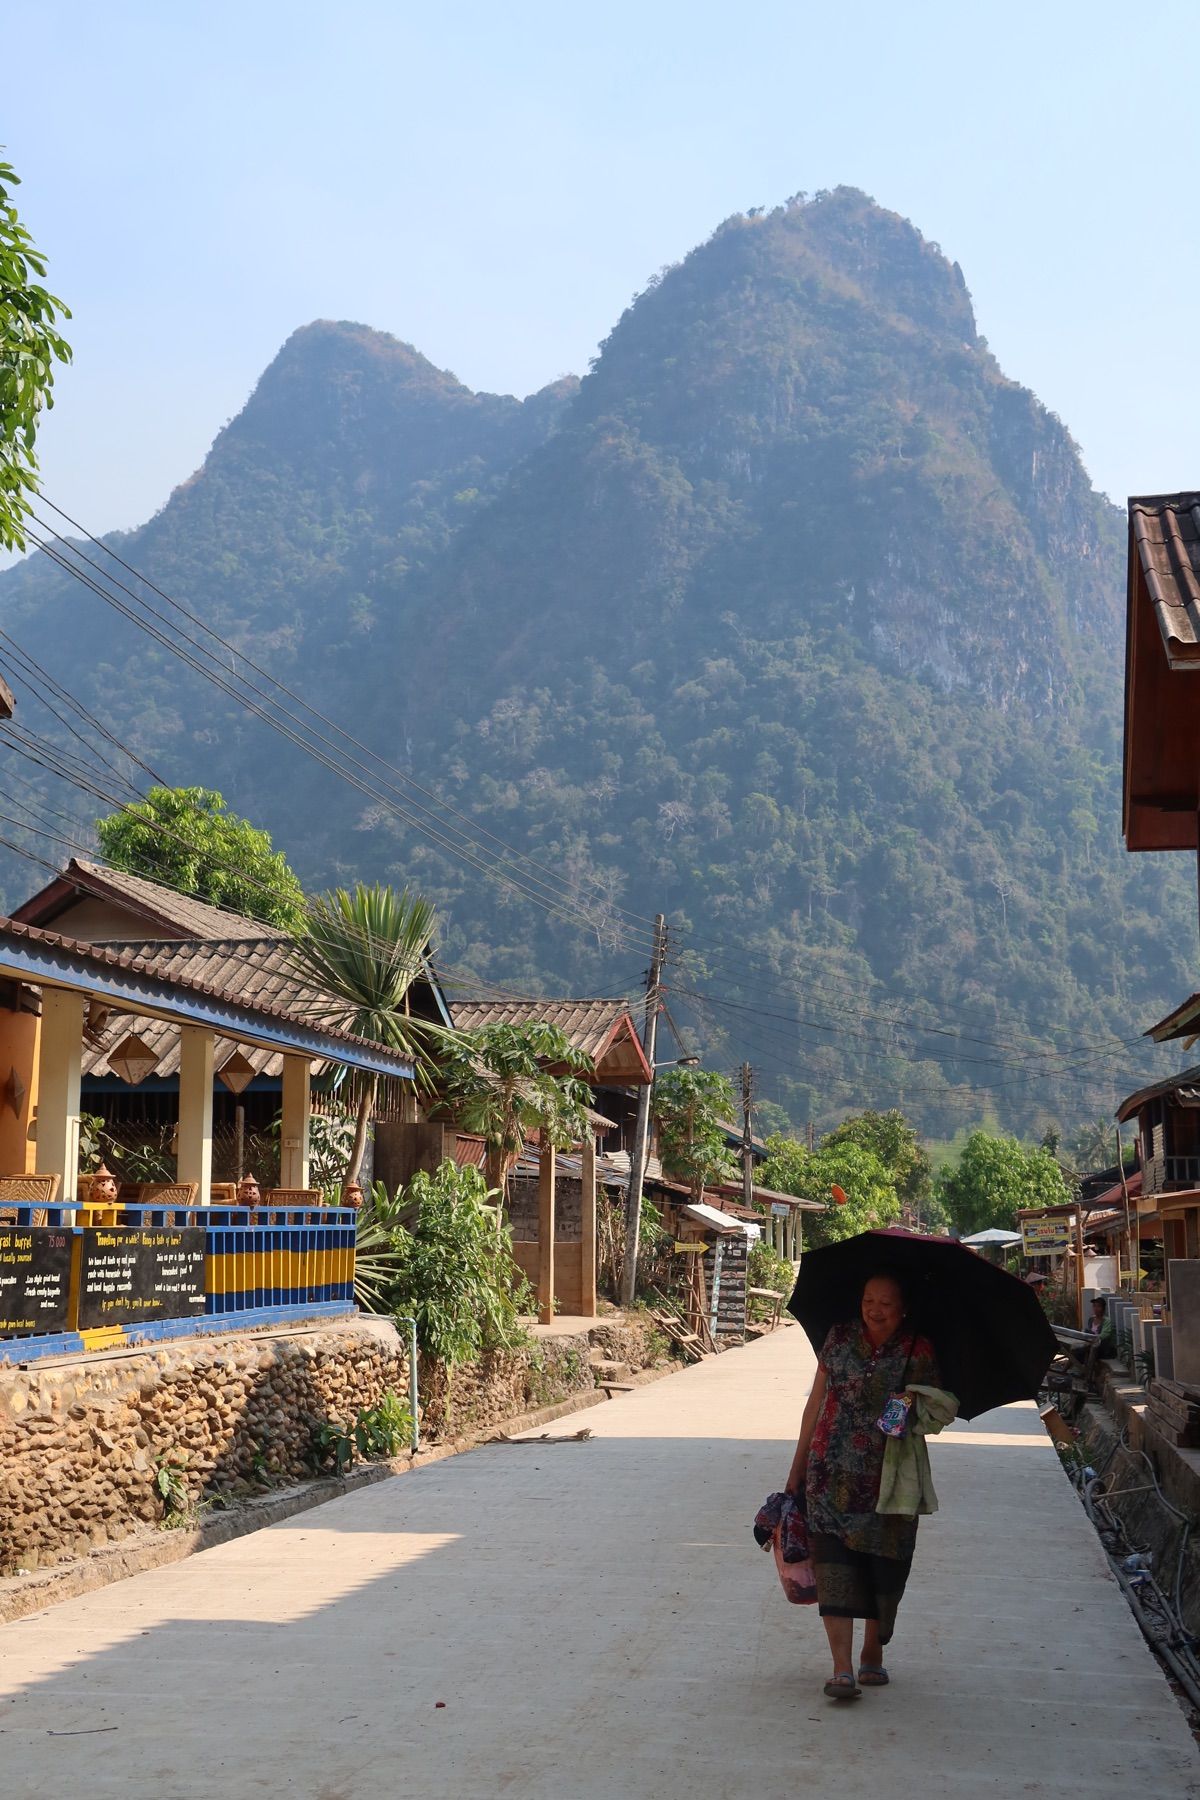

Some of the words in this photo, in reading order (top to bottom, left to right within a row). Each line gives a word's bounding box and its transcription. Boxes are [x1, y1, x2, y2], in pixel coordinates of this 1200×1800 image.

[15, 1234, 32, 1249] buffet
[166, 1236, 170, 1247] of
[3, 1252, 15, 1264] locally
[17, 1253, 32, 1262] sourced
[107, 1256, 115, 1264] kinds
[117, 1258, 120, 1267] of
[188, 1254, 191, 1262] of
[94, 1282, 102, 1291] local
